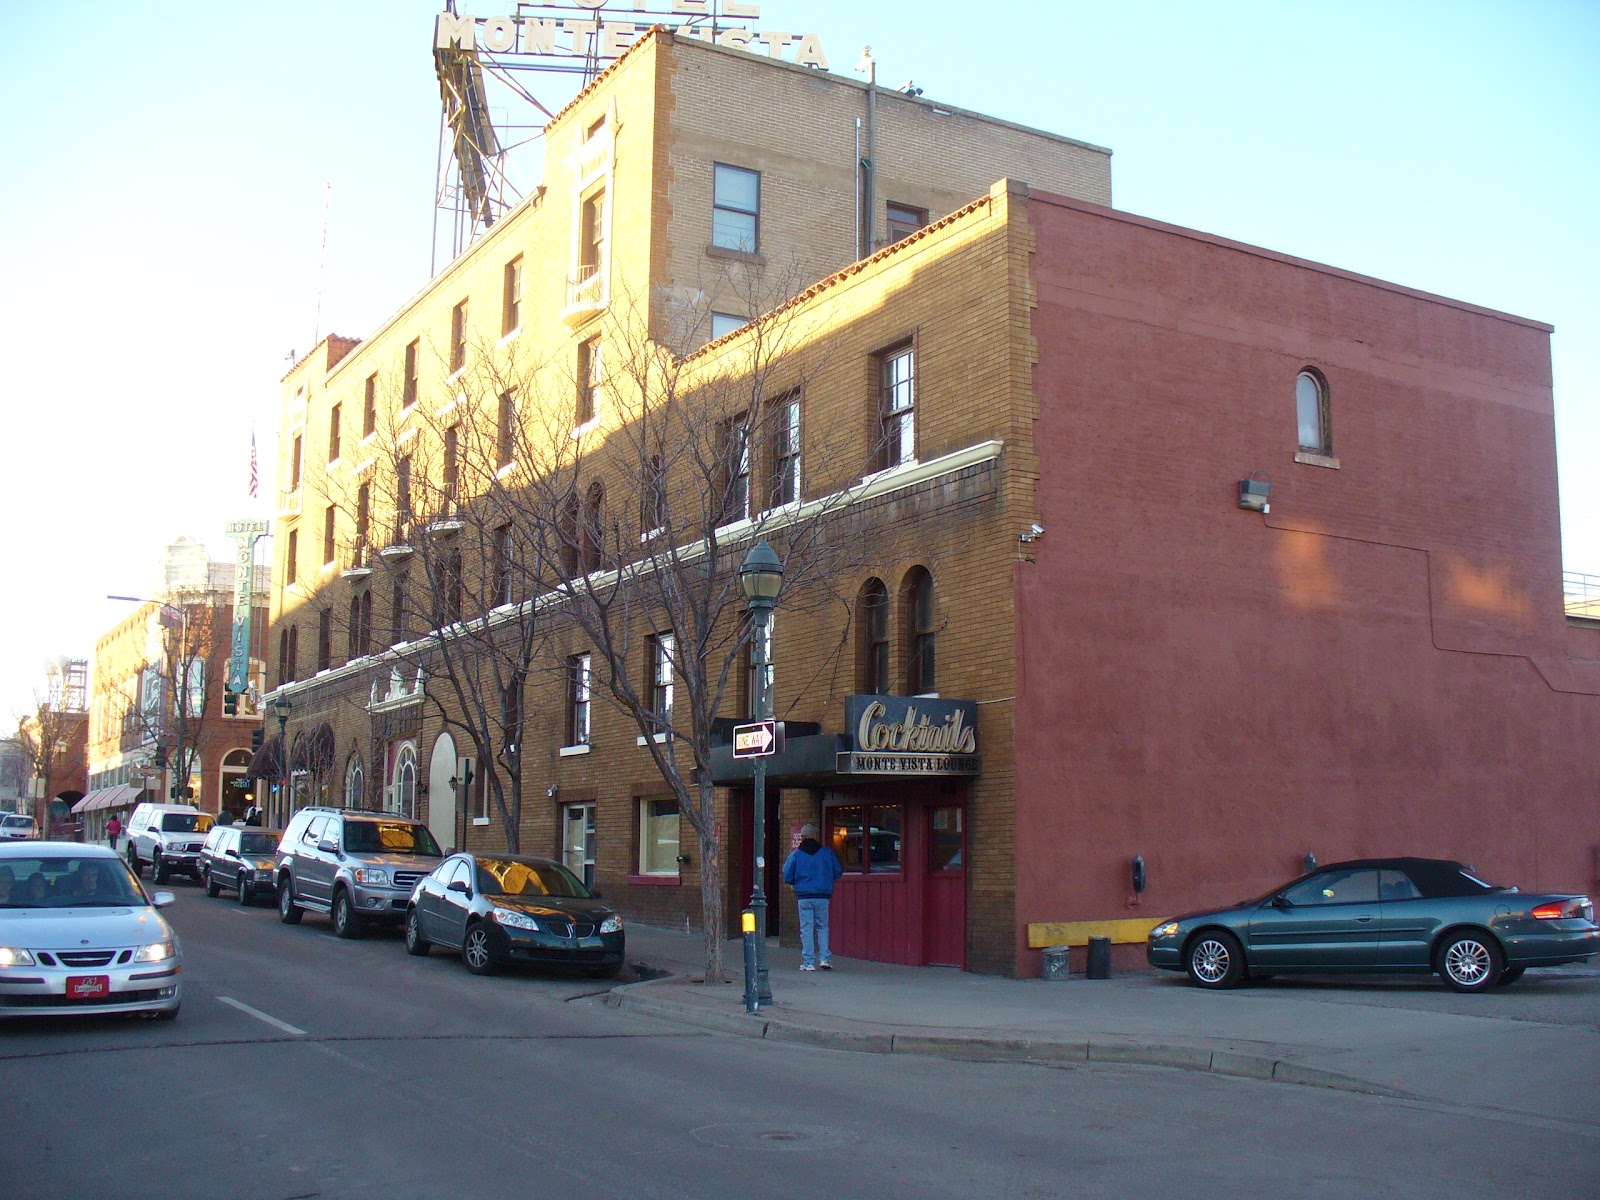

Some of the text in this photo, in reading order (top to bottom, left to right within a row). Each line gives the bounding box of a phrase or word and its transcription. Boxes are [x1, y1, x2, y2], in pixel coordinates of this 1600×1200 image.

[437, 14, 636, 57] MONTE
[227, 522, 264, 533] HOTEL
[233, 537, 250, 686] MONTE VISTA
[738, 733, 764, 747] ONE WAY
[859, 701, 976, 753] Cocktails
[857, 757, 979, 771] MONTE VISTA LOUNGE
